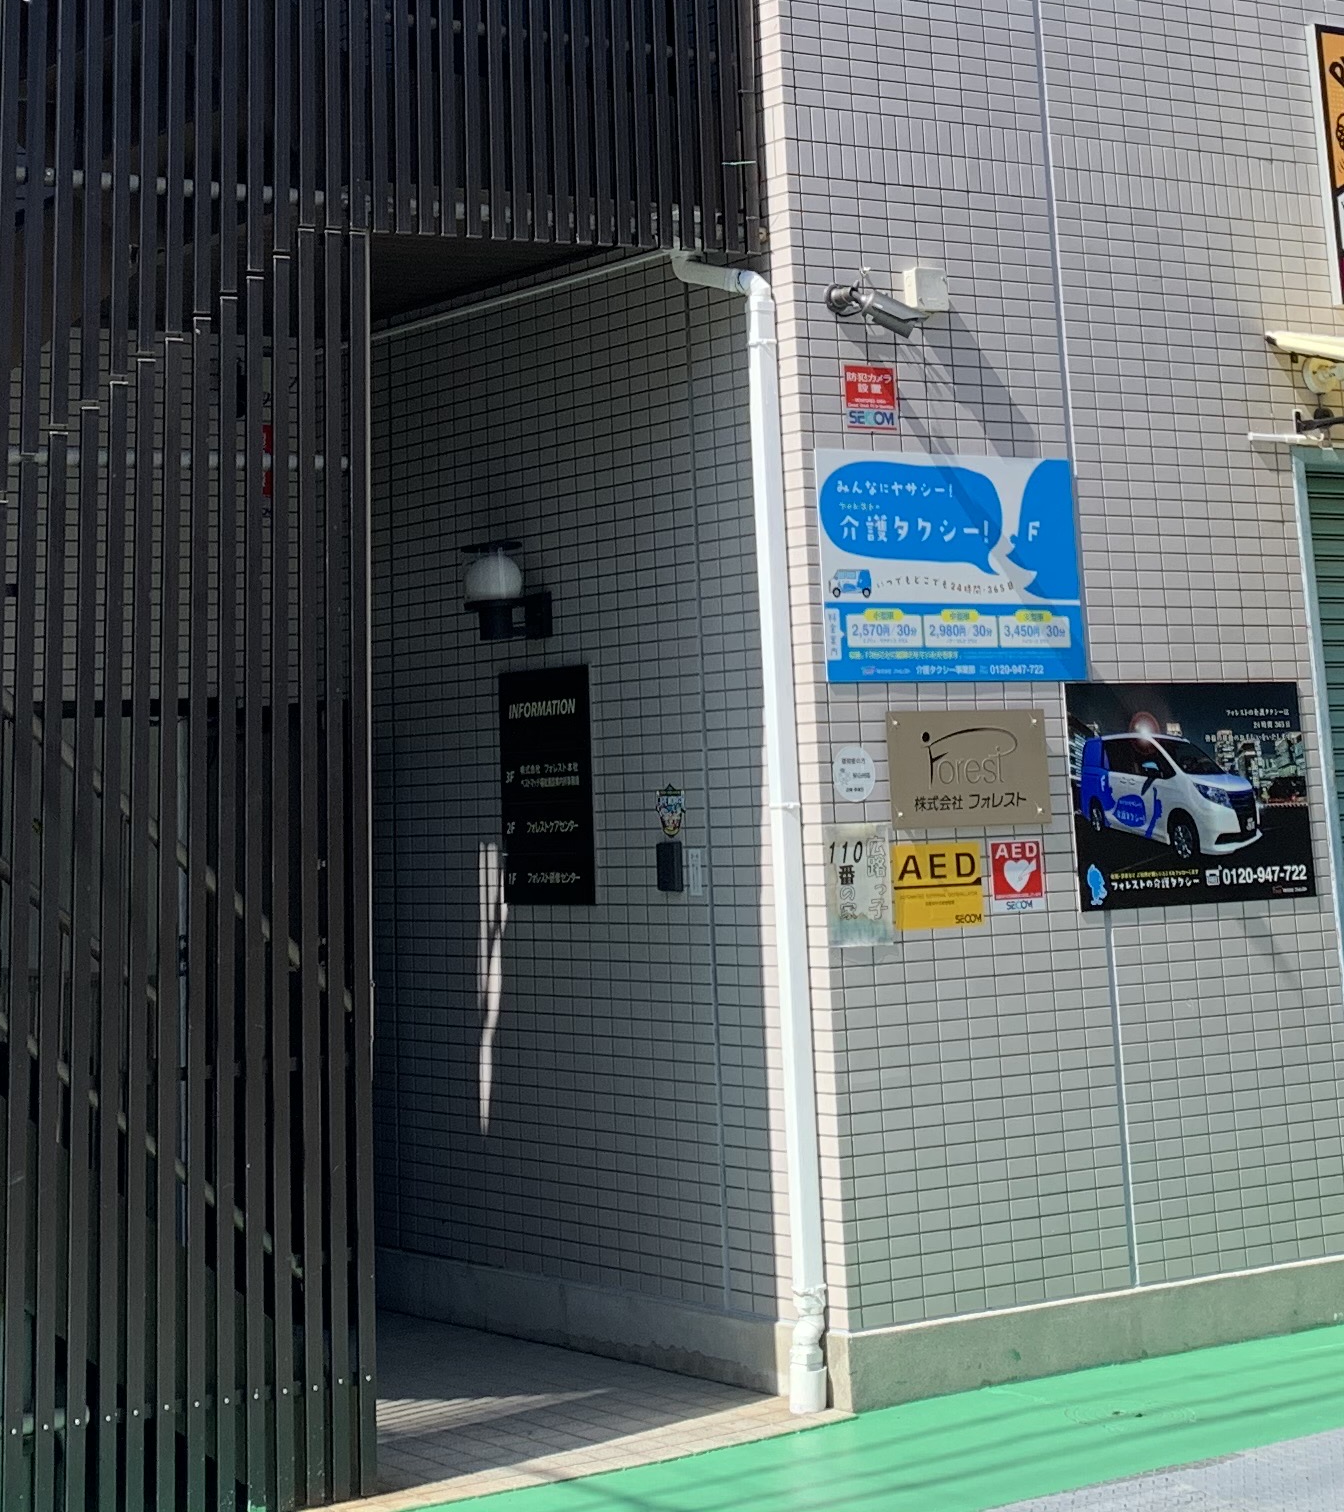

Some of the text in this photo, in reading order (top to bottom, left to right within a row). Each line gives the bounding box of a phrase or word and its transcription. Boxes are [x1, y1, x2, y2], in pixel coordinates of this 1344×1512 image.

[846, 372, 892, 384] 防犯カメラ
[849, 410, 894, 426] SECOM
[1028, 522, 1040, 541] F
[990, 665, 1044, 675] 0120-947-722
[509, 698, 576, 719] INFORMATION
[921, 727, 1018, 790] Forest
[914, 791, 1027, 812] 株式会社 フォレスト
[507, 822, 516, 834] 2F
[995, 843, 1038, 859] AED
[898, 852, 976, 882] AED
[1222, 864, 1308, 885] 0120-947-722
[1110, 877, 1200, 891] フォレストの介護タクシー
[1006, 900, 1033, 910] SECOM
[955, 913, 982, 924] SECOM
